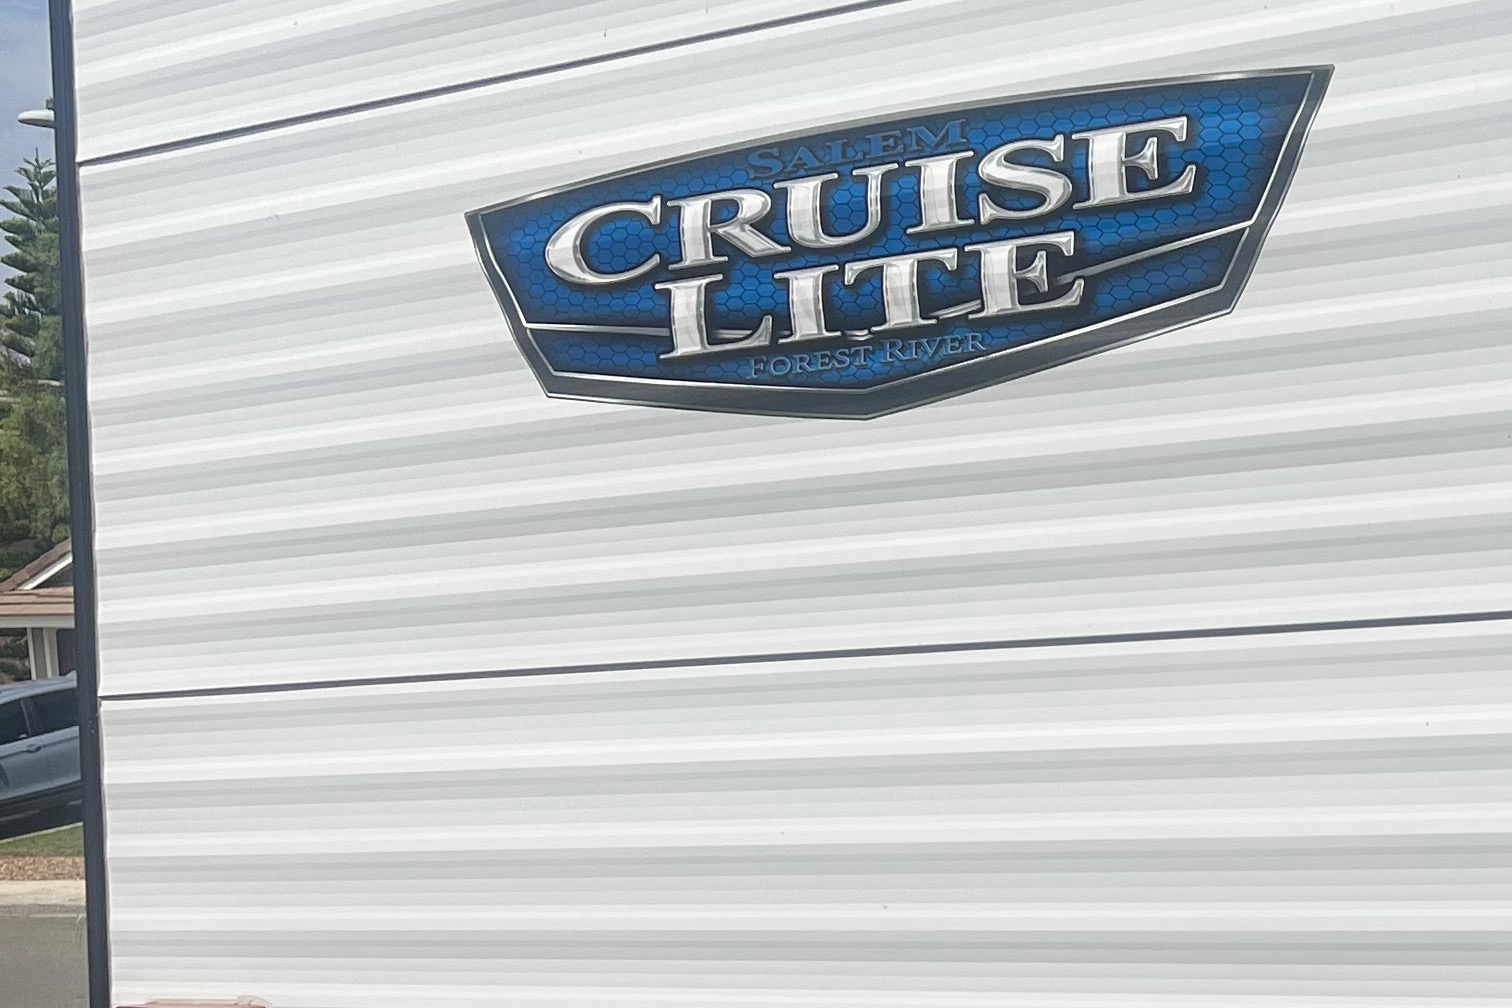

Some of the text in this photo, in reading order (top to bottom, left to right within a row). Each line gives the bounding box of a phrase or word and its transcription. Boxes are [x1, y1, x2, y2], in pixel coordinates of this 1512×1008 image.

[747, 118, 968, 179] SALEM
[544, 114, 1198, 286] CRUISE
[657, 230, 1087, 361] LITE
[745, 332, 988, 380] FOREST RIVER
